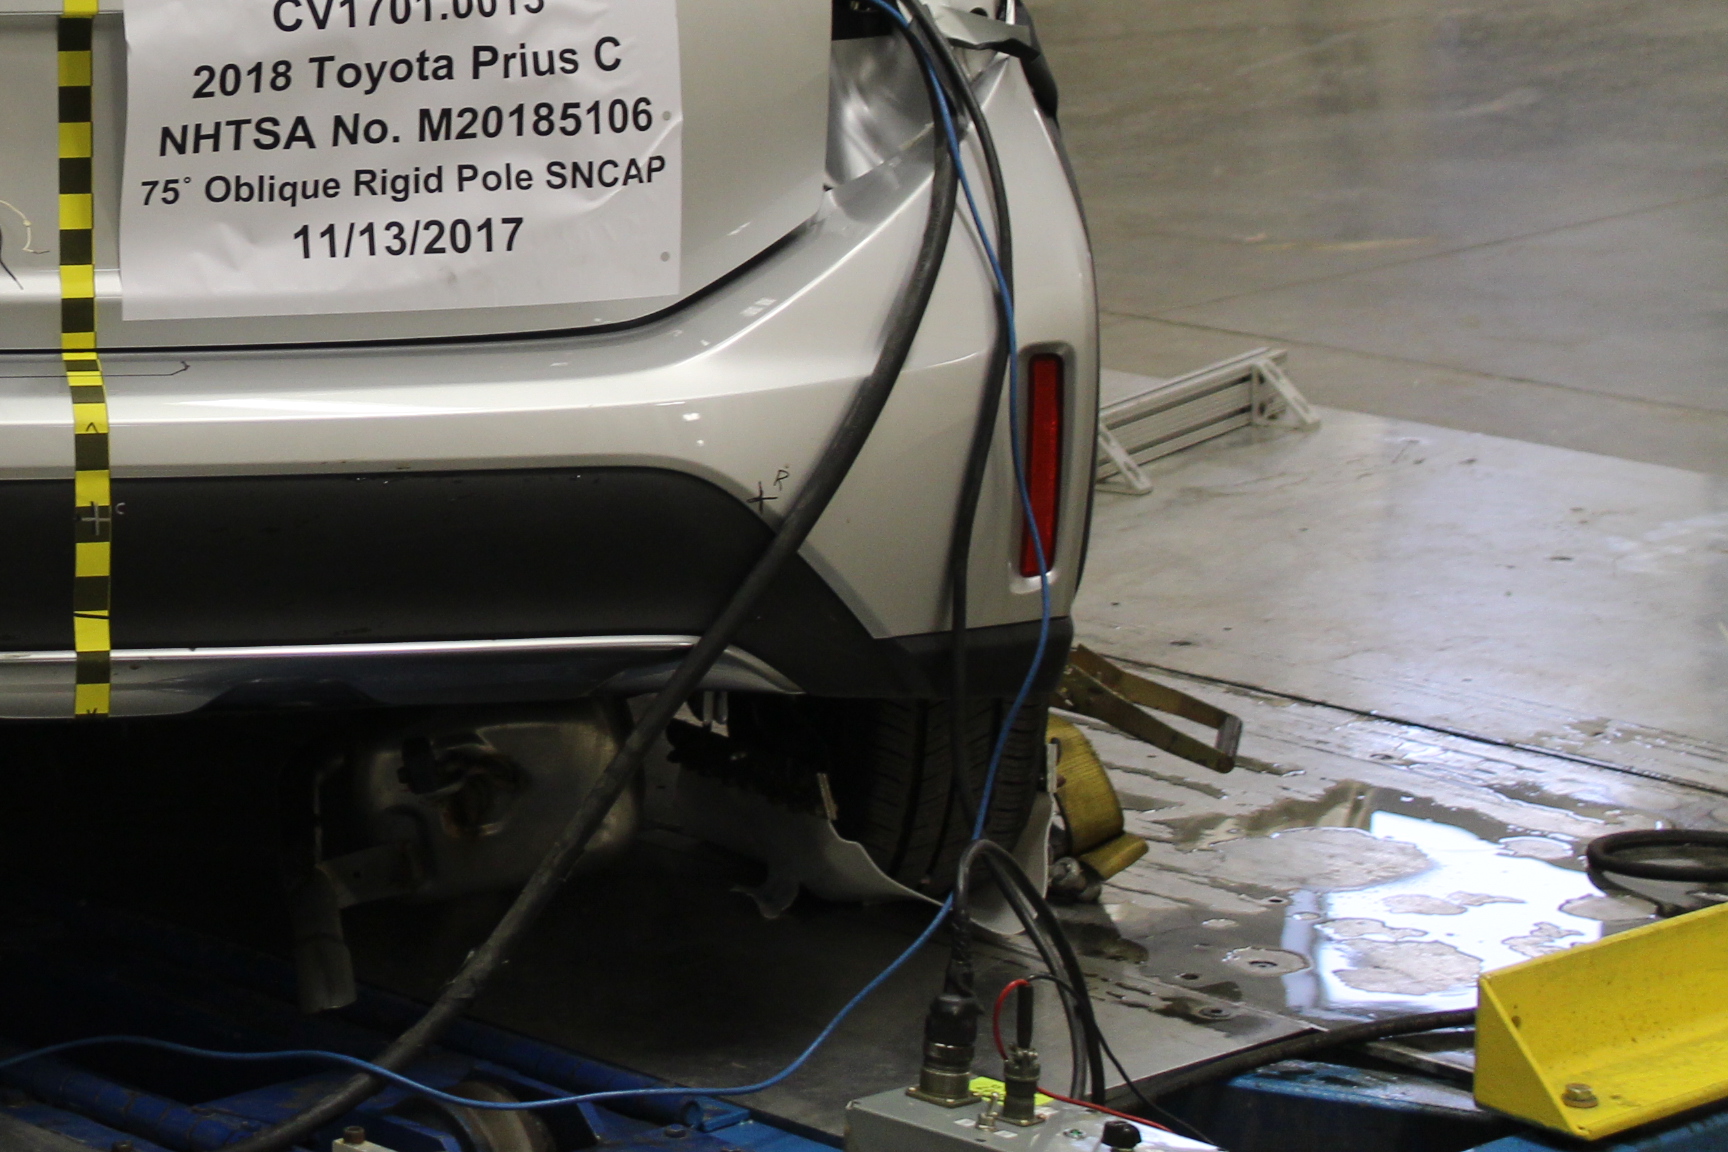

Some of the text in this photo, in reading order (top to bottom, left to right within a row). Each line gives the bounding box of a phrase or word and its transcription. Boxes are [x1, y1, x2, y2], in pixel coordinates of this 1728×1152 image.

[192, 35, 623, 100] 2018 Toyota Prius C
[159, 96, 654, 157] NHTSA No. M20185106
[204, 170, 341, 208] Oblique
[353, 163, 444, 203] Rigid
[458, 163, 534, 194] Pole
[545, 154, 667, 191] SNCAP
[292, 216, 526, 260] 11/13/2017
